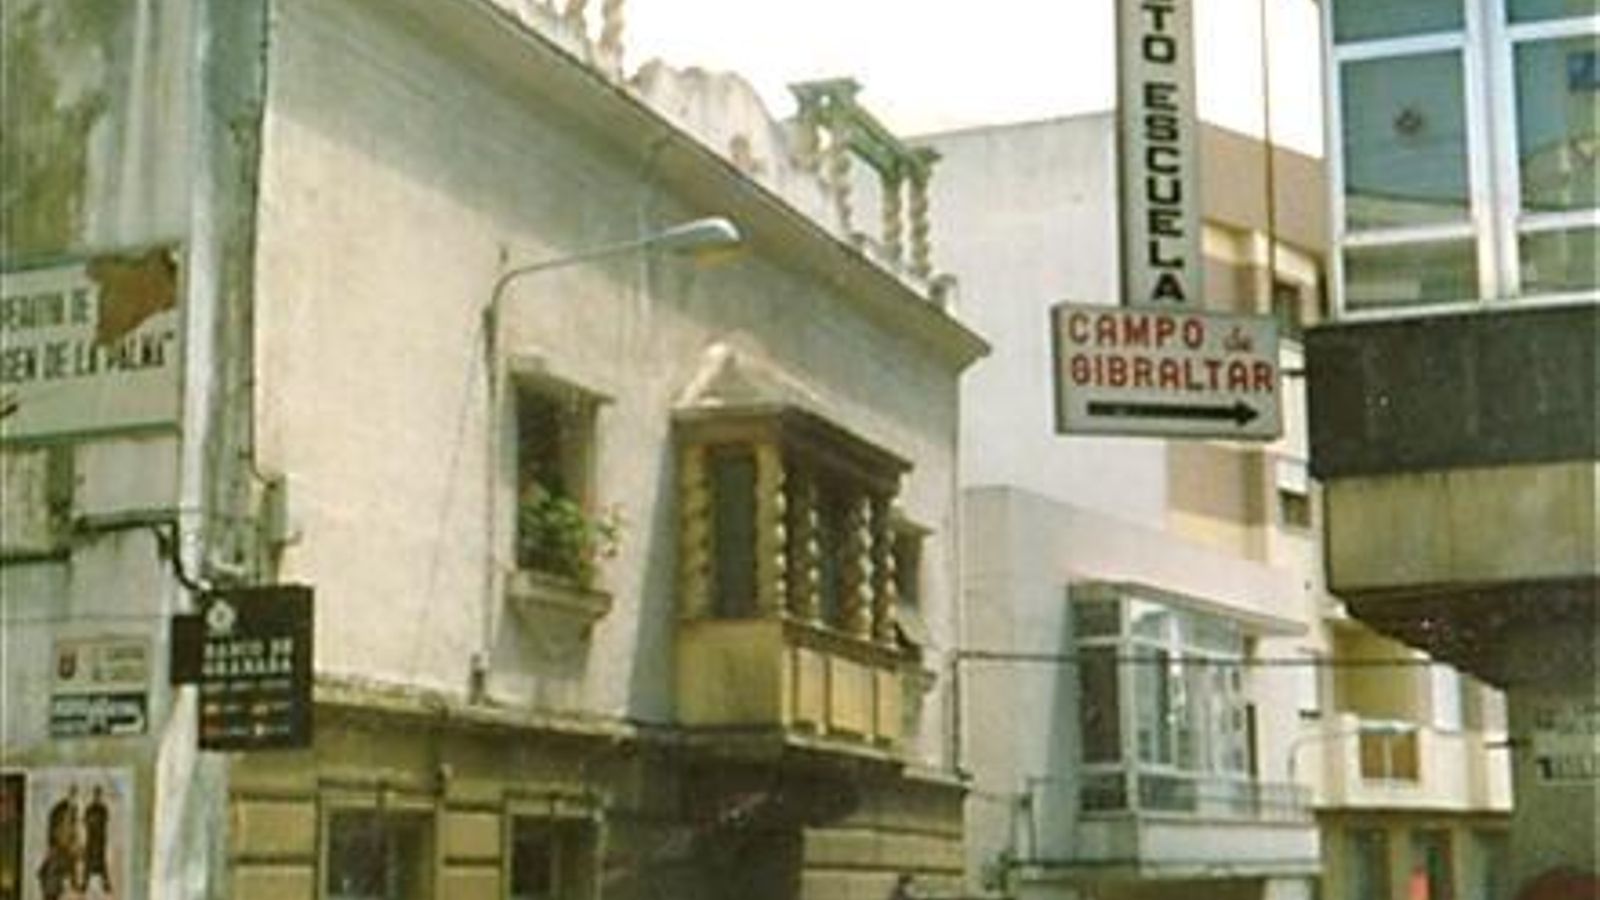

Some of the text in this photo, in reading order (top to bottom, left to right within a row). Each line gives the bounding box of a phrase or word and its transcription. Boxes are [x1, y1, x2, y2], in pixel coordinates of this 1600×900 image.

[1141, 0, 1186, 301] TO ESCUELA
[1067, 311, 1205, 349] CAMPO
[1071, 352, 1274, 393] GIBRALTAR
